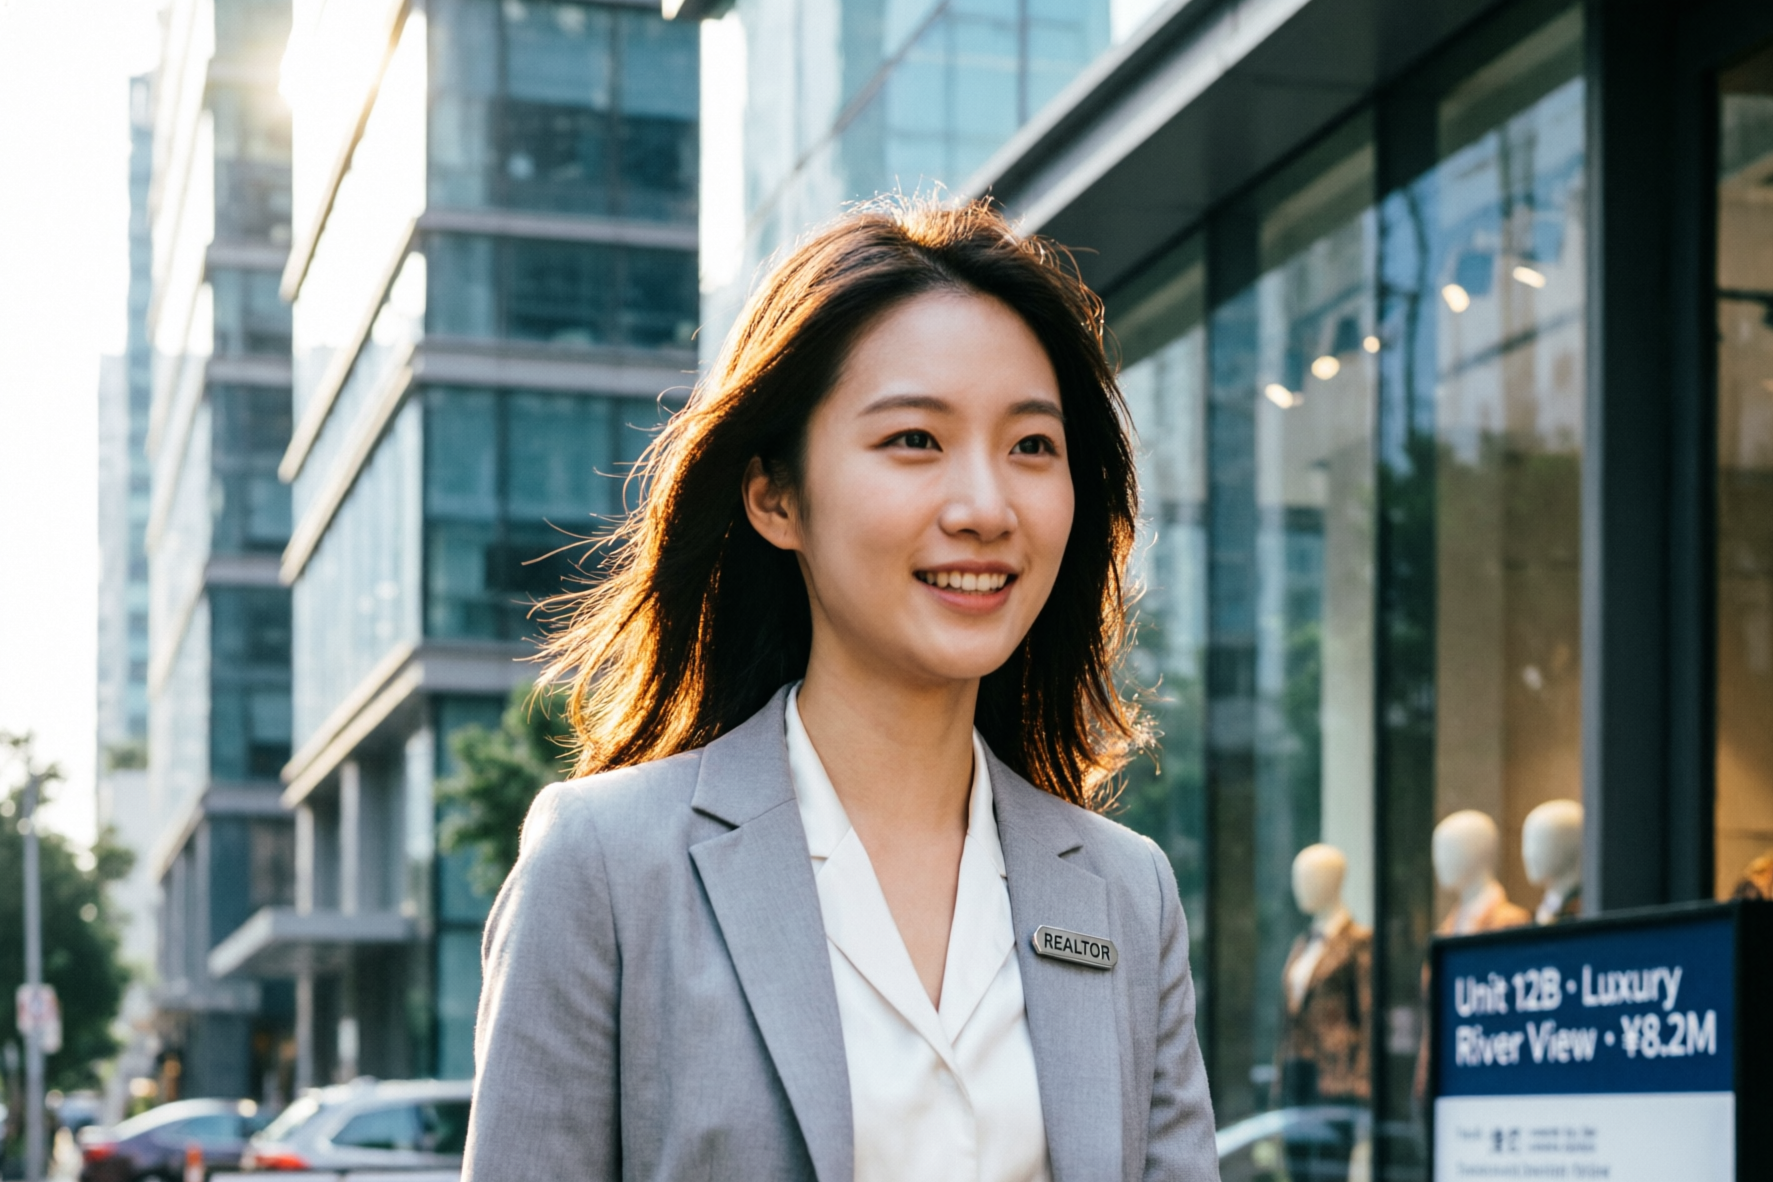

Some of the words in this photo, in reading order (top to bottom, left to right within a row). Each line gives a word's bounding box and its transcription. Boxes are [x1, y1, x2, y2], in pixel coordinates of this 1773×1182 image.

[1044, 932, 1111, 961] REALTOR
[1454, 972, 1508, 1017] Unit
[1512, 967, 1562, 1012] 12B
[1582, 963, 1682, 1011] Luxury
[1455, 1024, 1523, 1066] River
[1526, 1019, 1598, 1063] View
[1621, 1010, 1717, 1058] ¥8.2M
